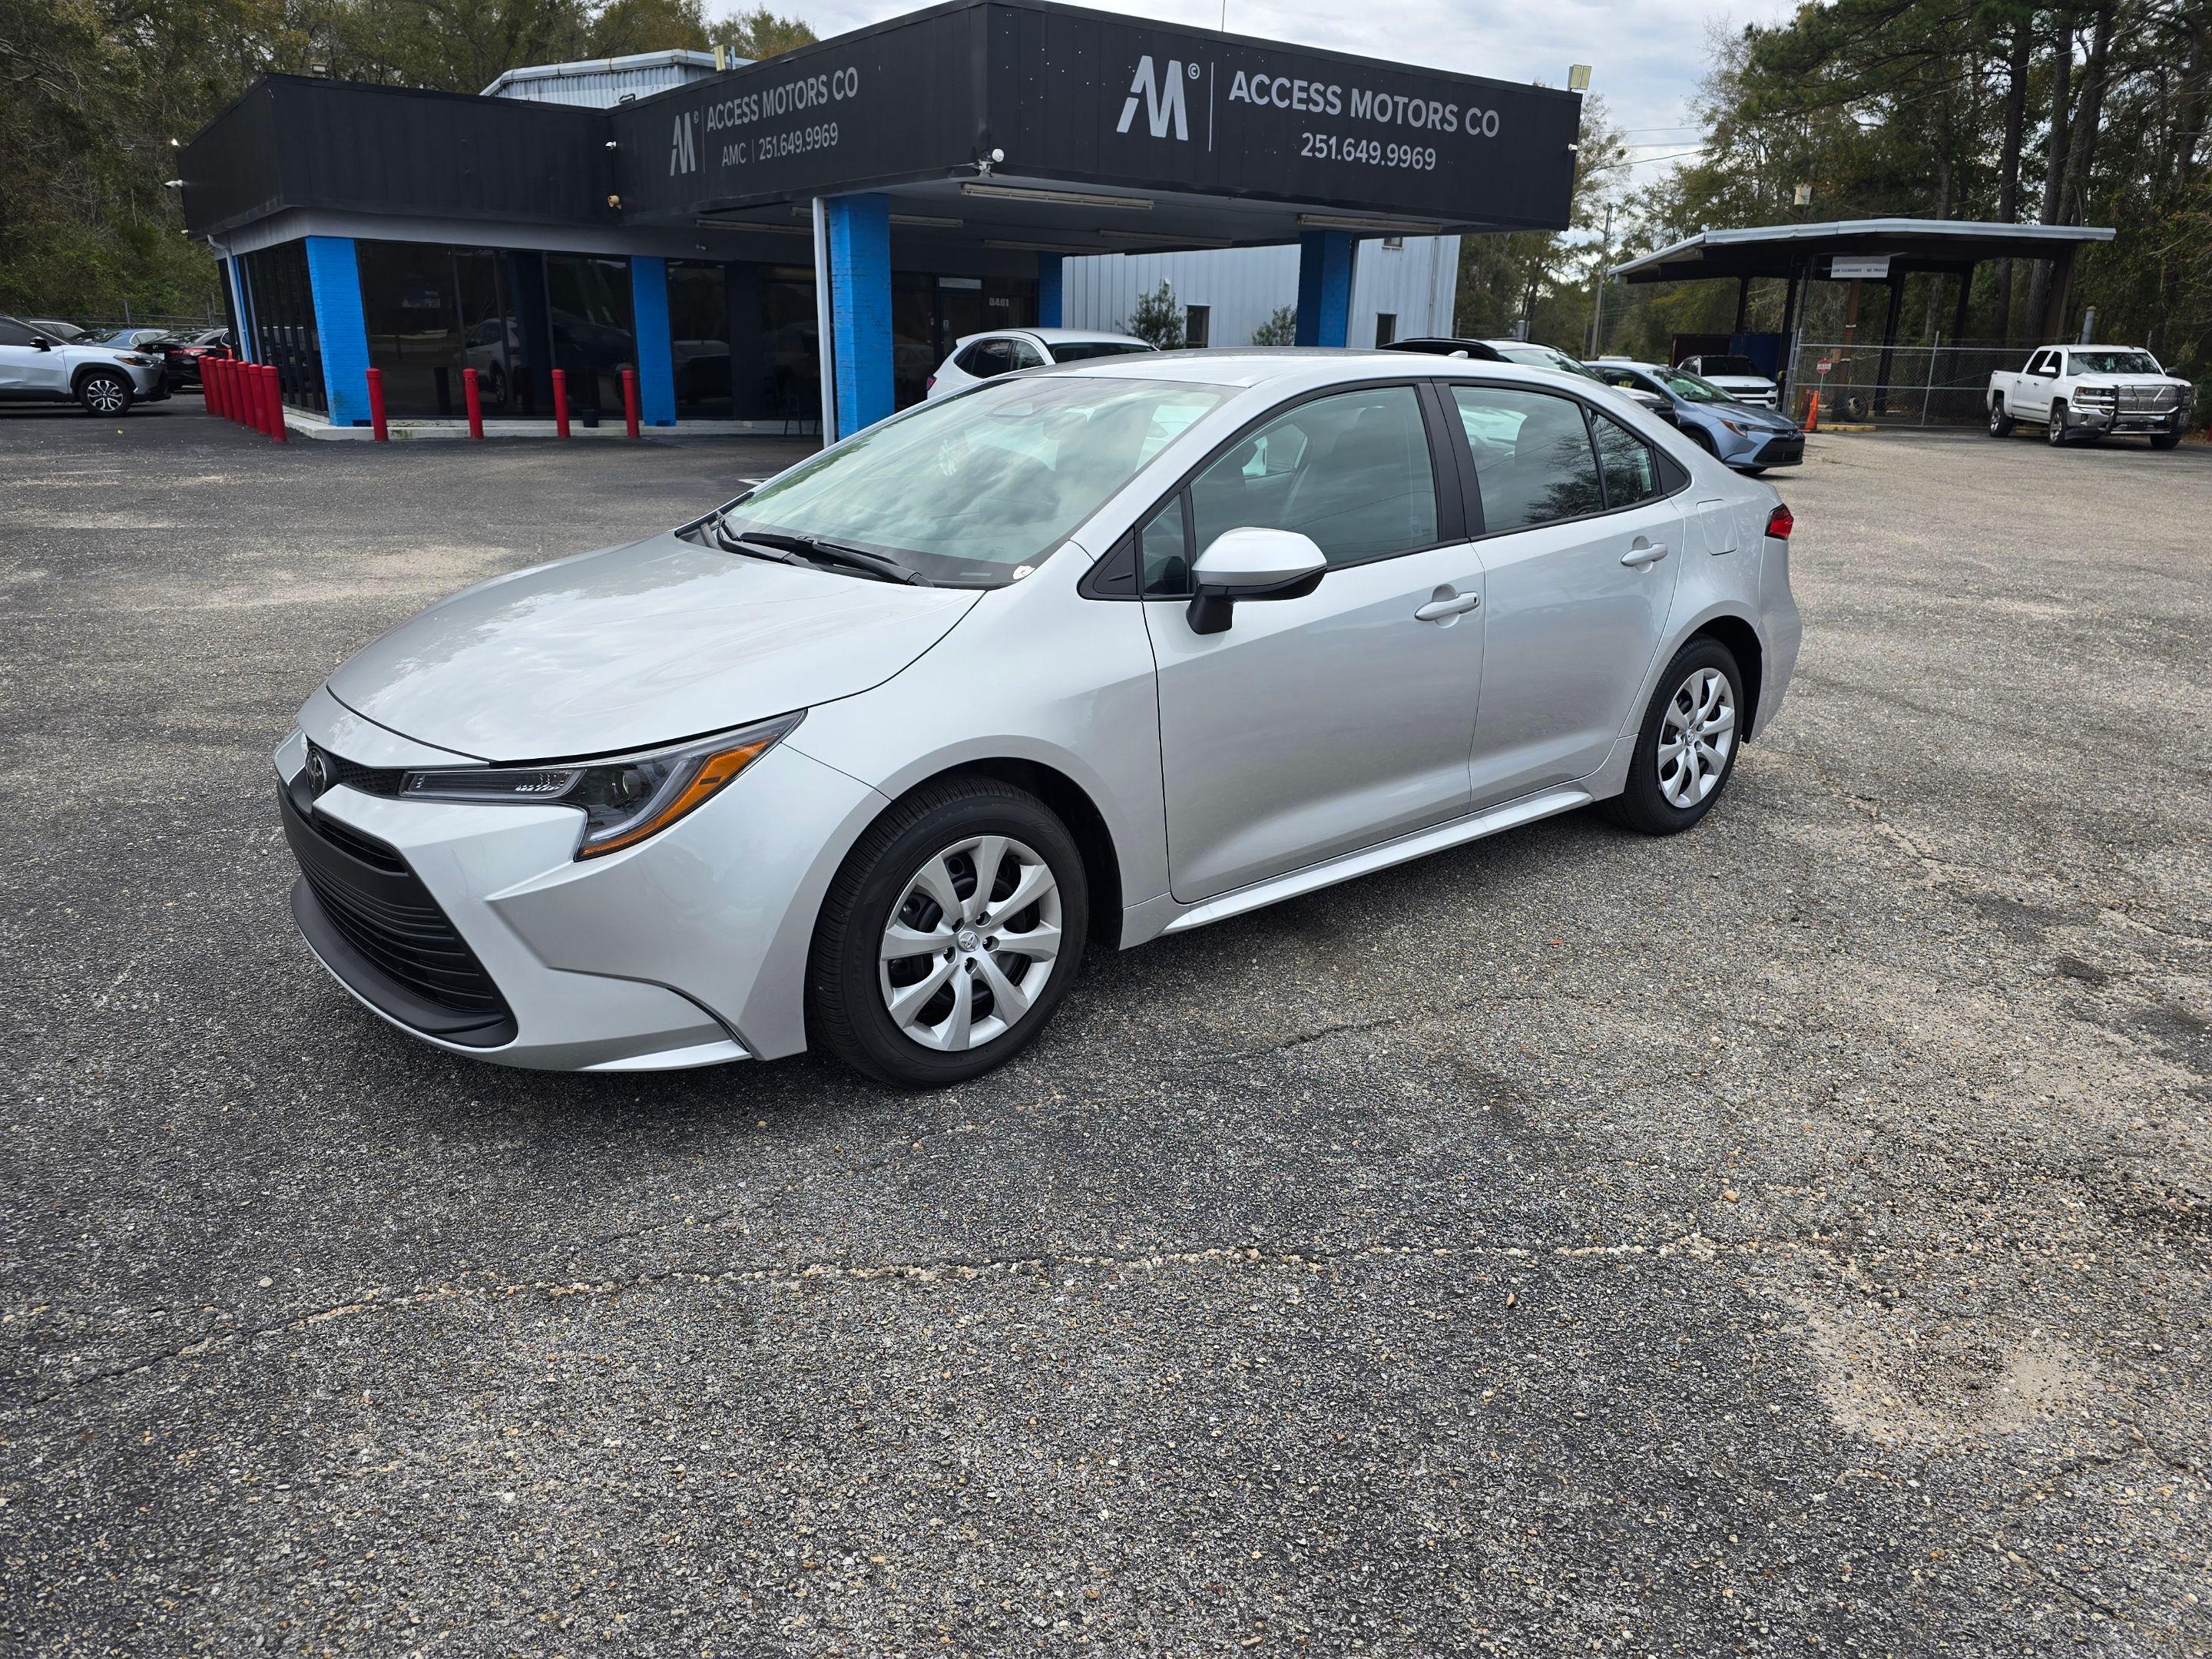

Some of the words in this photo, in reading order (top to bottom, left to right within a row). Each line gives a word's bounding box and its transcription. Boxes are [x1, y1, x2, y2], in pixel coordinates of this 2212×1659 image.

[707, 93, 759, 132] ACCESS
[763, 74, 829, 118] MOTORS
[833, 66, 859, 101] CO
[1228, 70, 1342, 115] ACCESS
[1349, 88, 1458, 132] MOTORS
[1465, 107, 1500, 138] CO
[721, 142, 747, 167] AMC
[758, 121, 839, 161] 251.649.9969
[1300, 131, 1436, 171] 251.649.9969
[988, 297, 1009, 307] 8461
